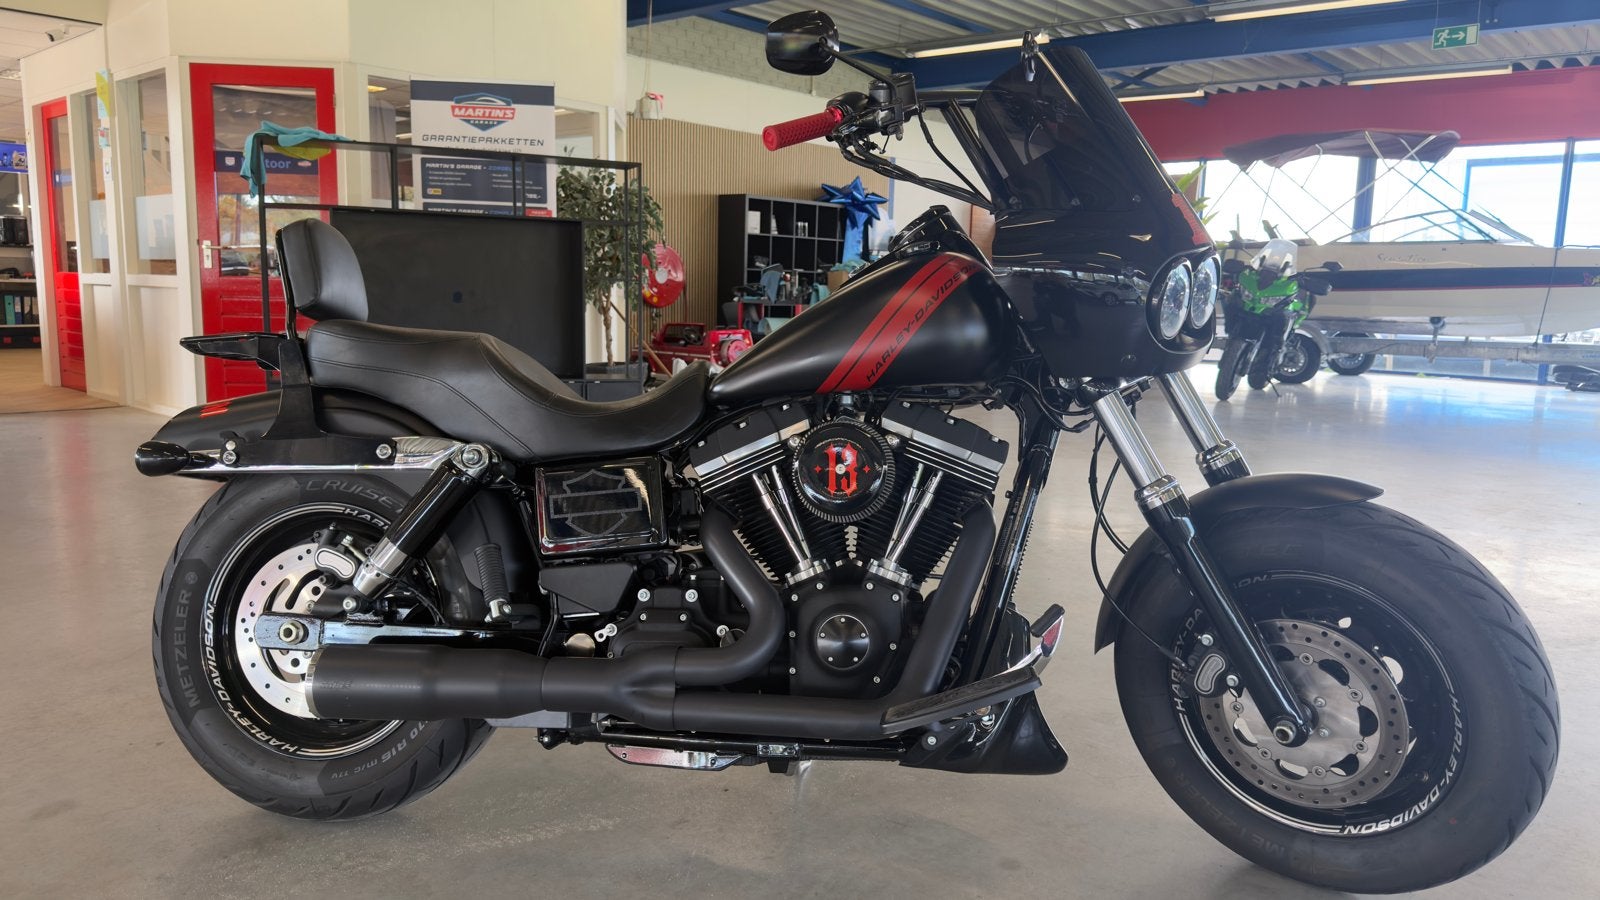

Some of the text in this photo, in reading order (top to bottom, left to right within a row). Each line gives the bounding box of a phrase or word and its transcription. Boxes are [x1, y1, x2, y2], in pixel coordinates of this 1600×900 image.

[421, 134, 545, 147] GARANTIEPAKKETTEN
[866, 263, 977, 382] HARLEY-DAVIDSON
[174, 590, 200, 707] METZELER
[204, 602, 298, 754] HARLEY-DAVIDSON
[1344, 693, 1463, 835] HARLEY-DAVIDSON
